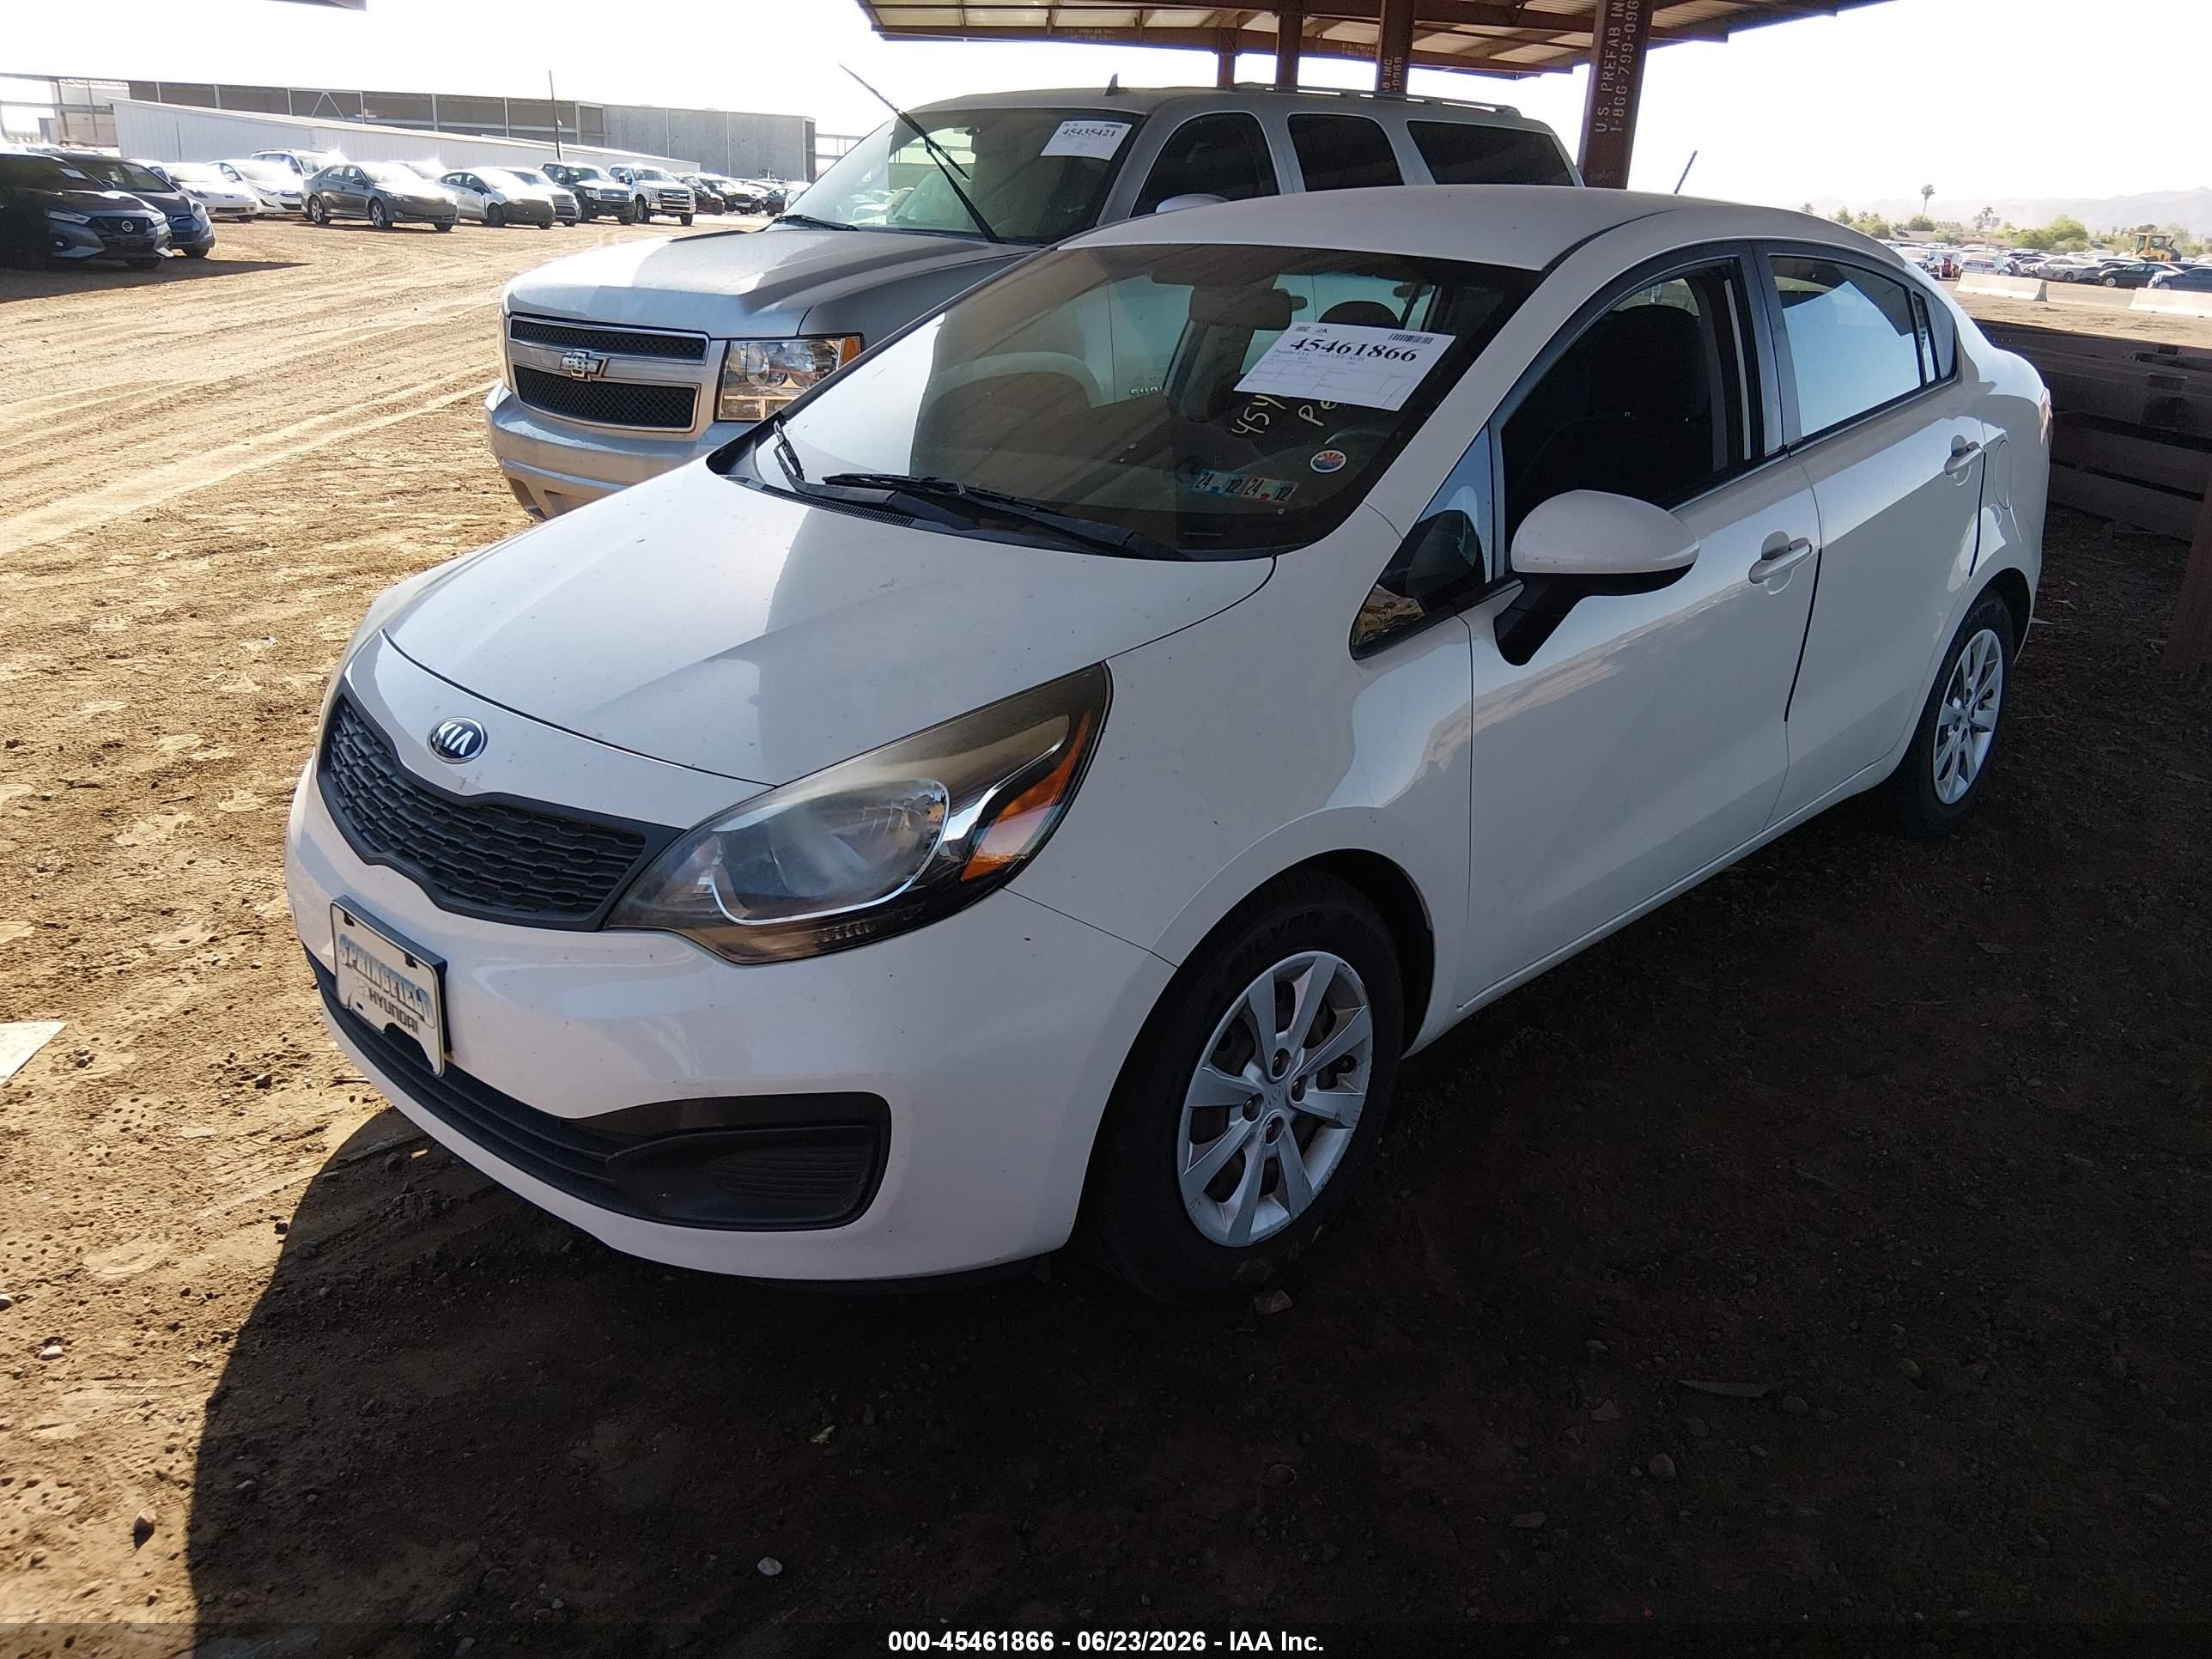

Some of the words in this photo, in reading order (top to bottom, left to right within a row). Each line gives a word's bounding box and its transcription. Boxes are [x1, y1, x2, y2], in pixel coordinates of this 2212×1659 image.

[1610, 0, 1625, 18] IN
[1601, 27, 1621, 92] PREFAB
[1595, 102, 1611, 132] U.S.
[1290, 338, 1422, 362] 45461866
[1231, 394, 1287, 434] 454
[1243, 478, 1265, 495] 24
[432, 721, 474, 756] KIA
[368, 987, 419, 1035] HYUNDAI
